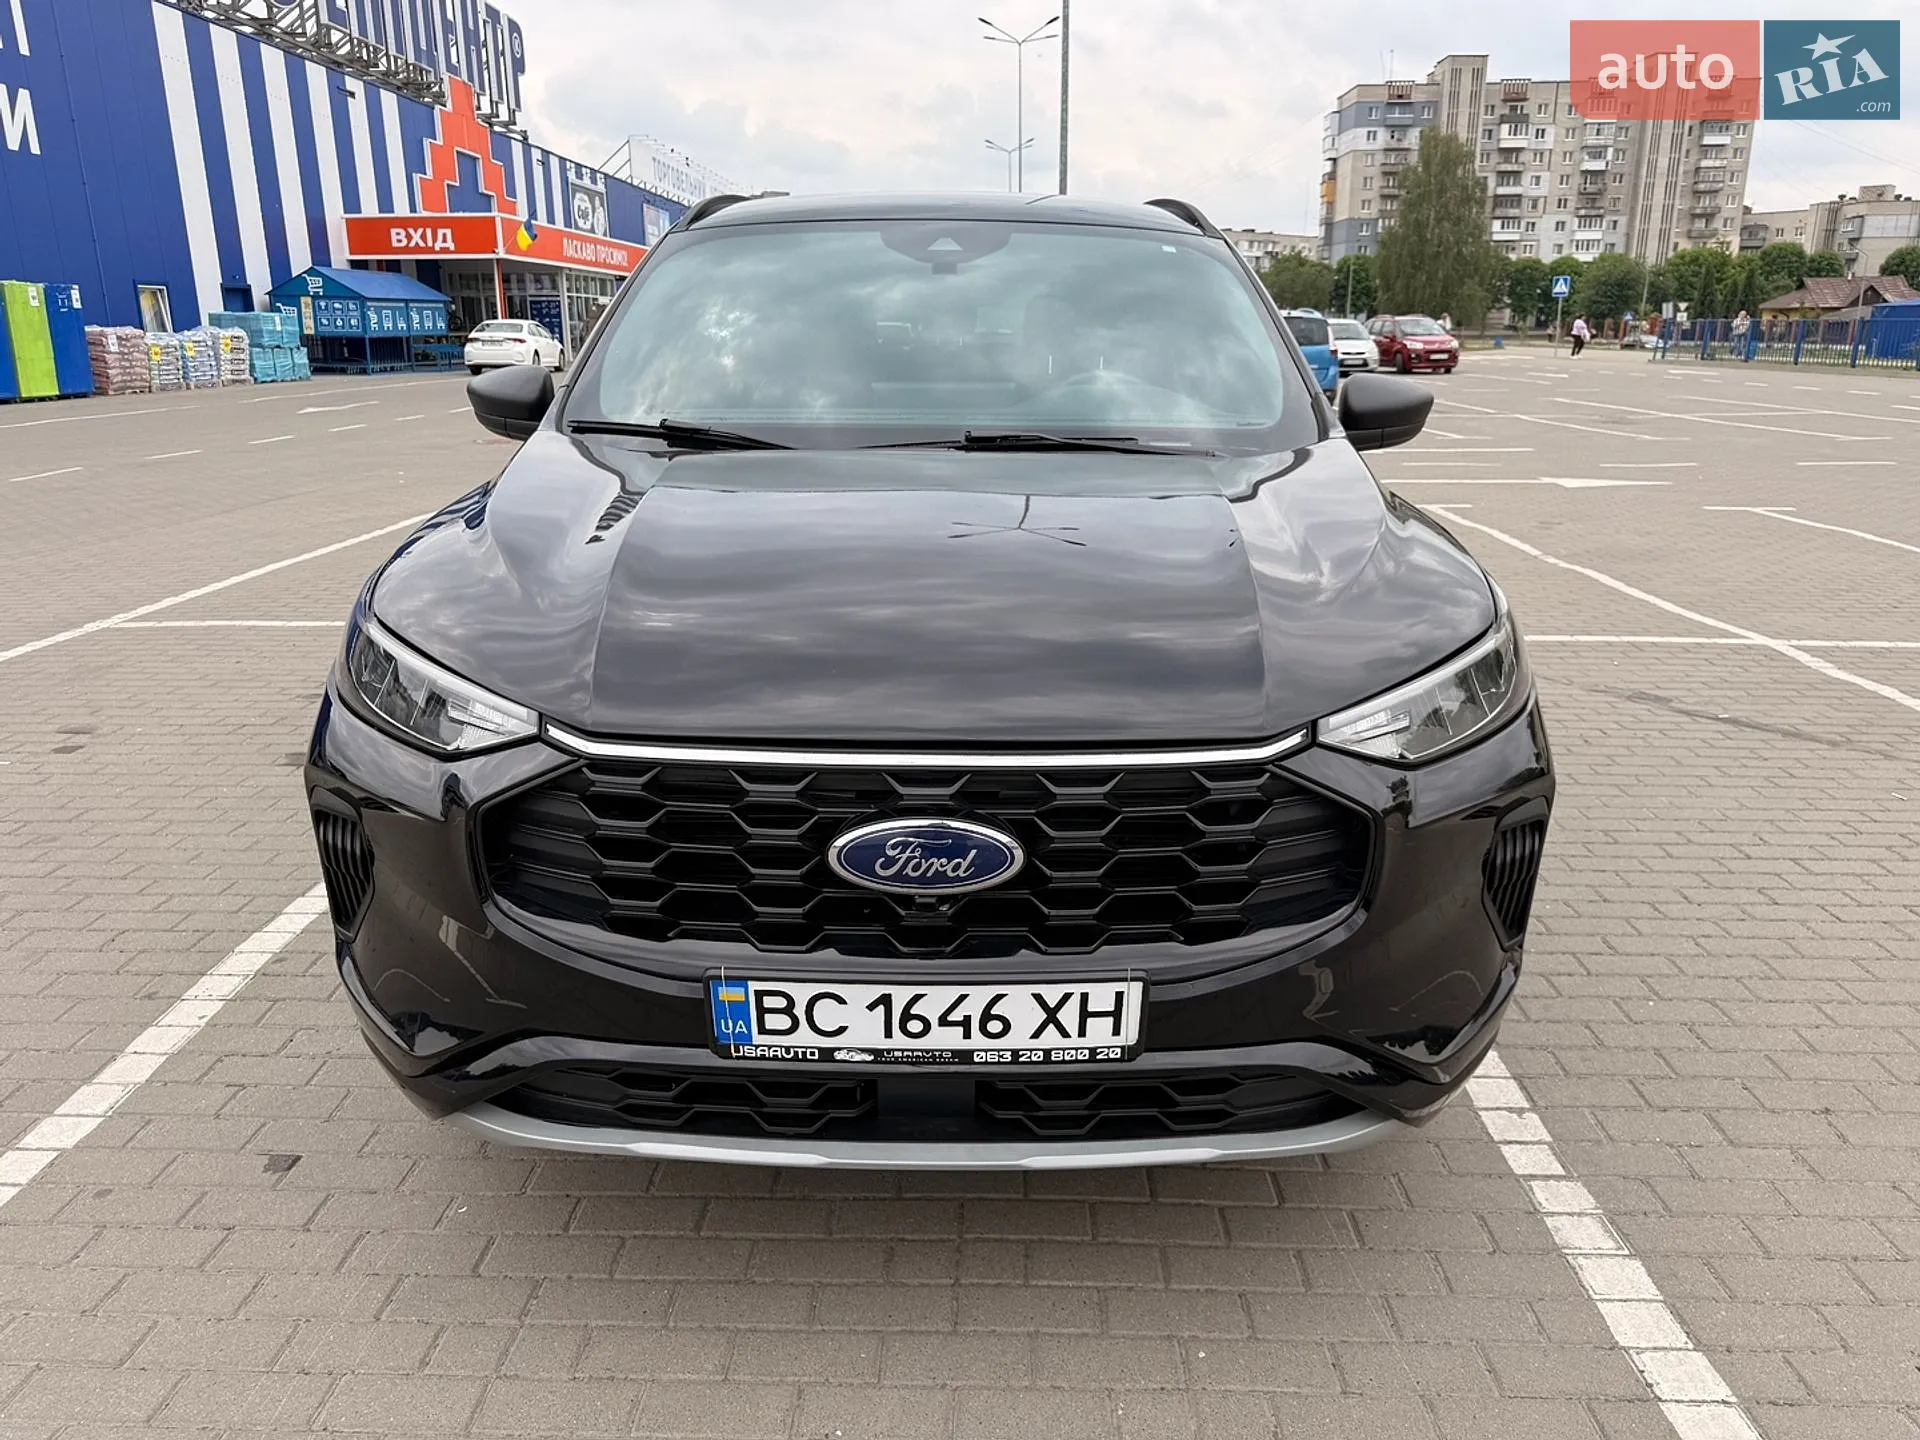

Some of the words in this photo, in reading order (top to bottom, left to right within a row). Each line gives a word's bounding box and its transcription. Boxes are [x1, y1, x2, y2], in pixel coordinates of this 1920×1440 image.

[390, 227, 455, 251] ВХІД
[562, 237, 596, 262] ЛАСКАВО
[874, 837, 978, 878] Ford
[721, 1018, 748, 1035] UA
[754, 989, 849, 1038] BC
[865, 992, 1012, 1040] 1646
[1029, 990, 1126, 1039] XH
[973, 1051, 1012, 1063] 063
[1018, 1050, 1044, 1062] 20
[1050, 1049, 1089, 1061] 800
[1095, 1047, 1122, 1059] 20
